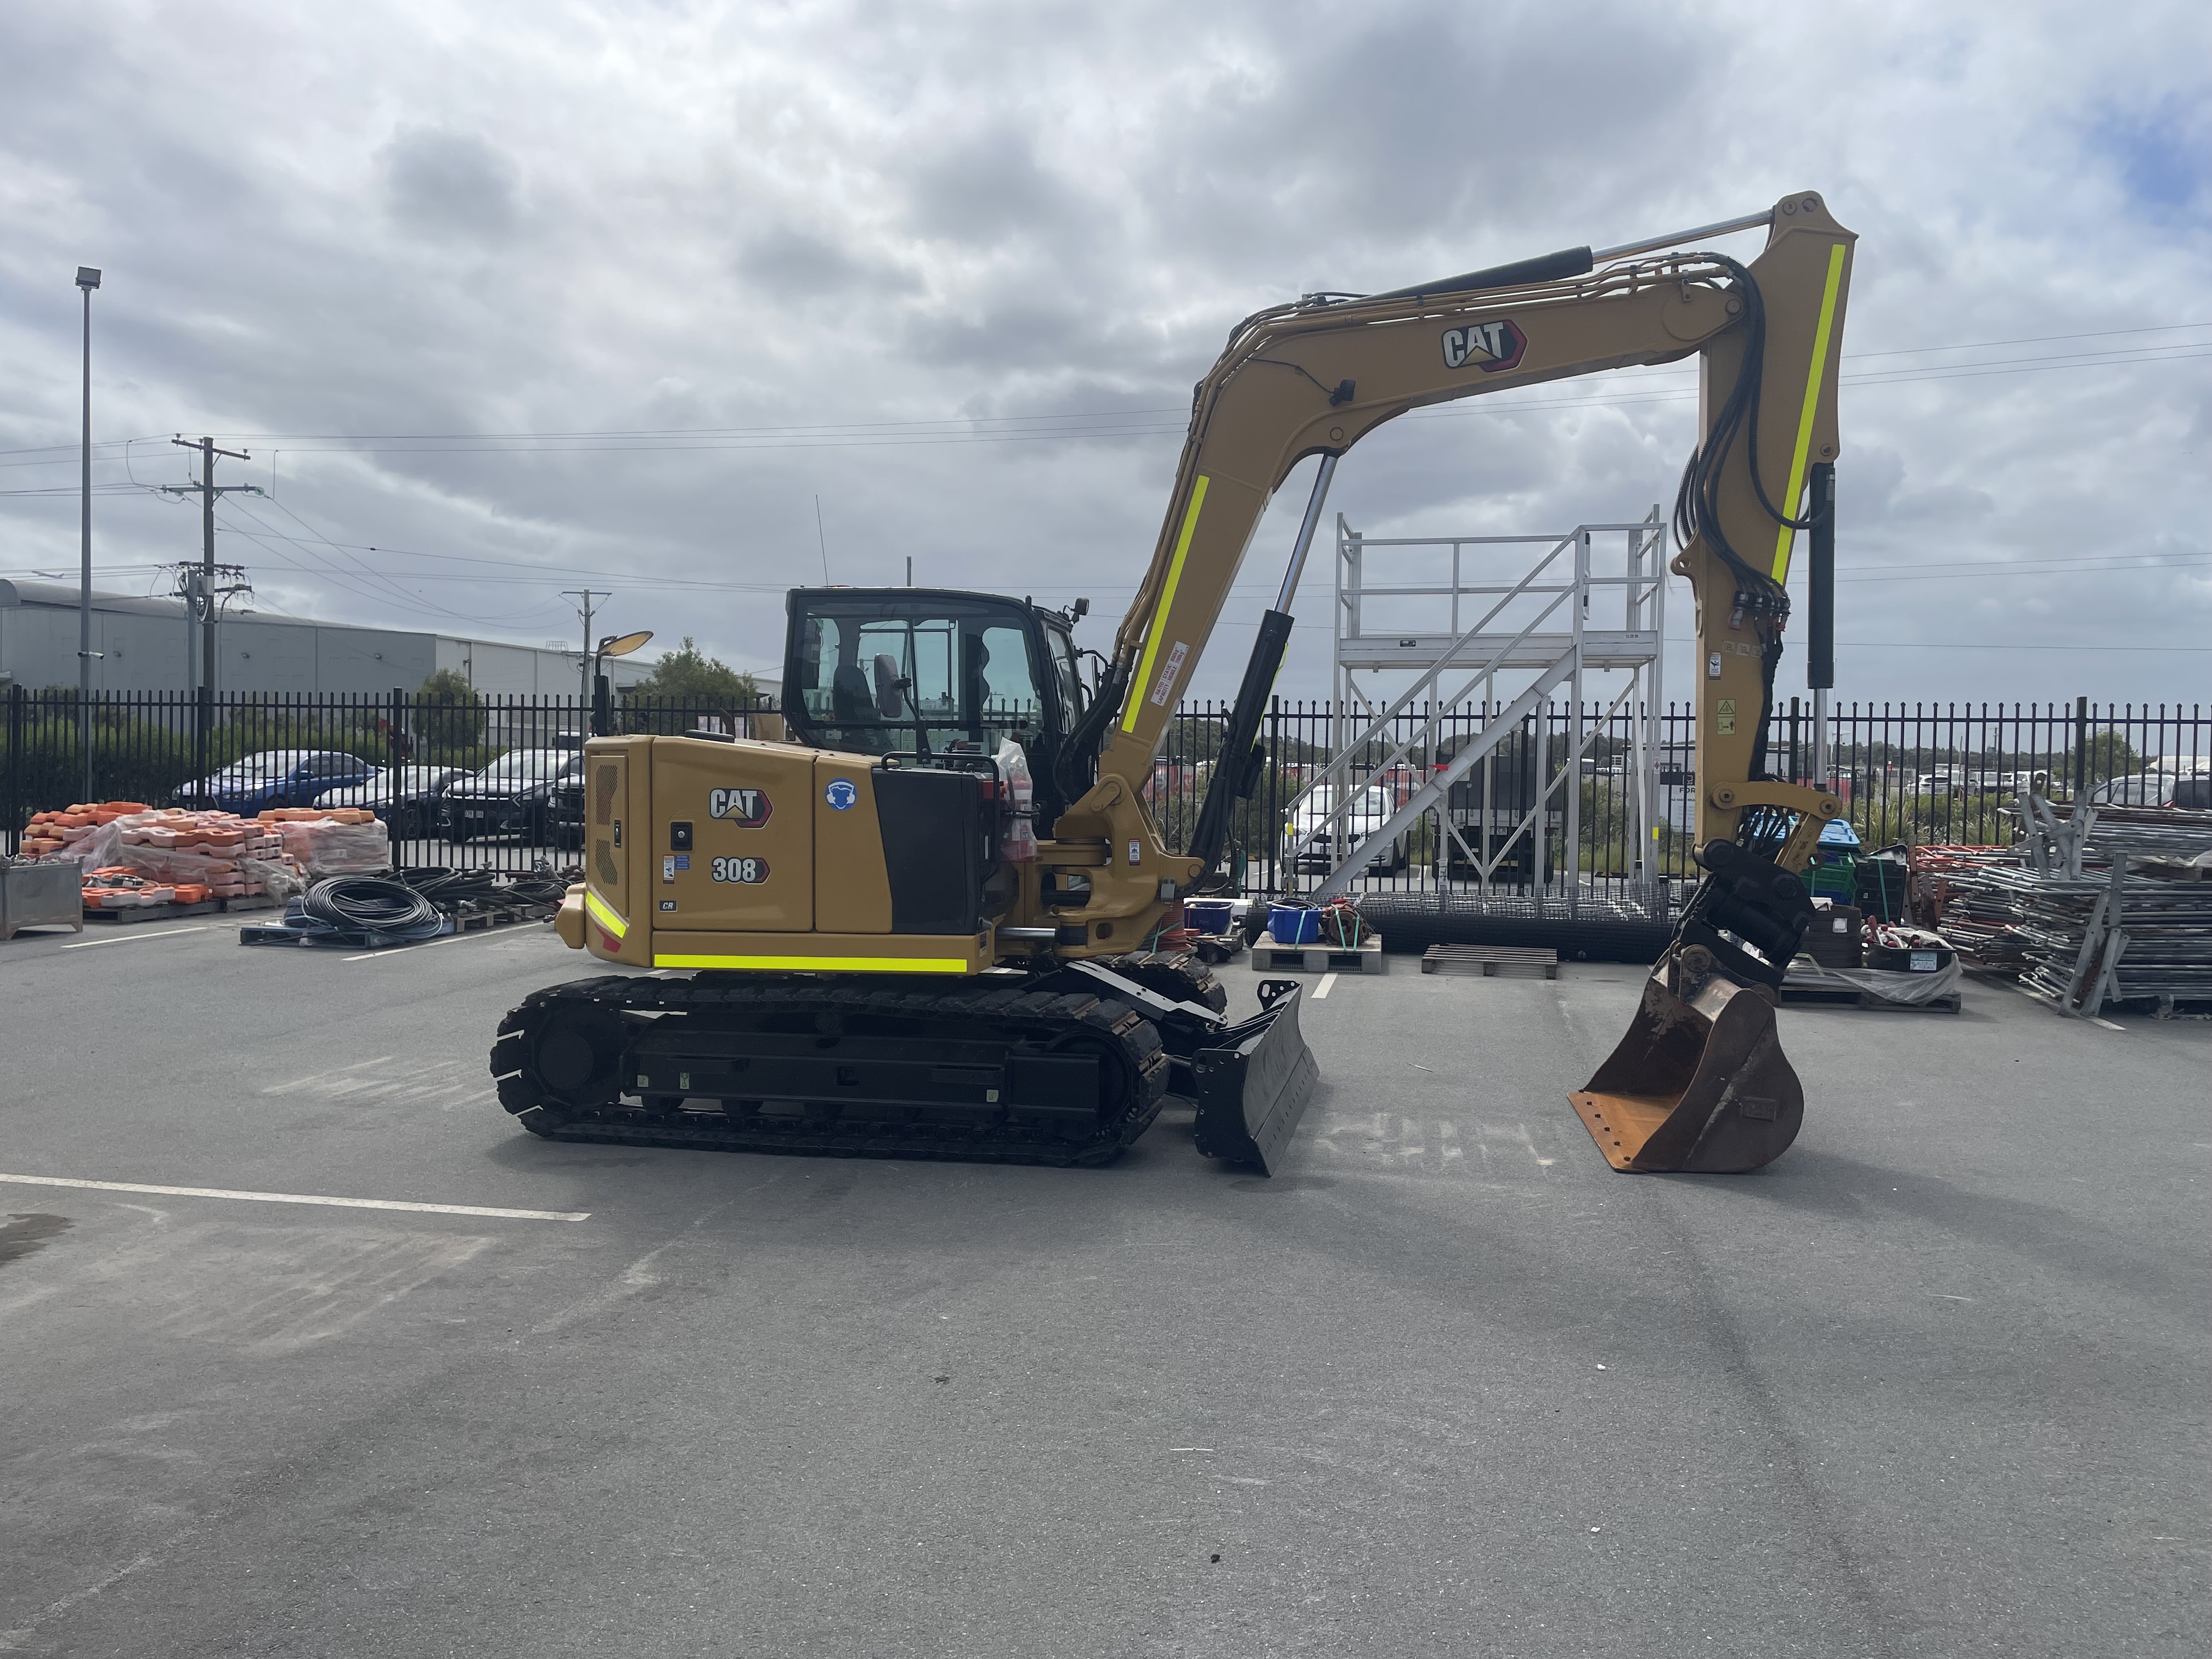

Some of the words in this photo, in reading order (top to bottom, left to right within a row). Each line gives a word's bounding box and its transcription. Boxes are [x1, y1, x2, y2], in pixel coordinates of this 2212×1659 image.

[1443, 321, 1503, 367] CAT
[1155, 681, 1164, 695] RATED
[1157, 684, 1169, 704] CAPACITY
[710, 789, 757, 819] CAT
[713, 857, 756, 882] 308
